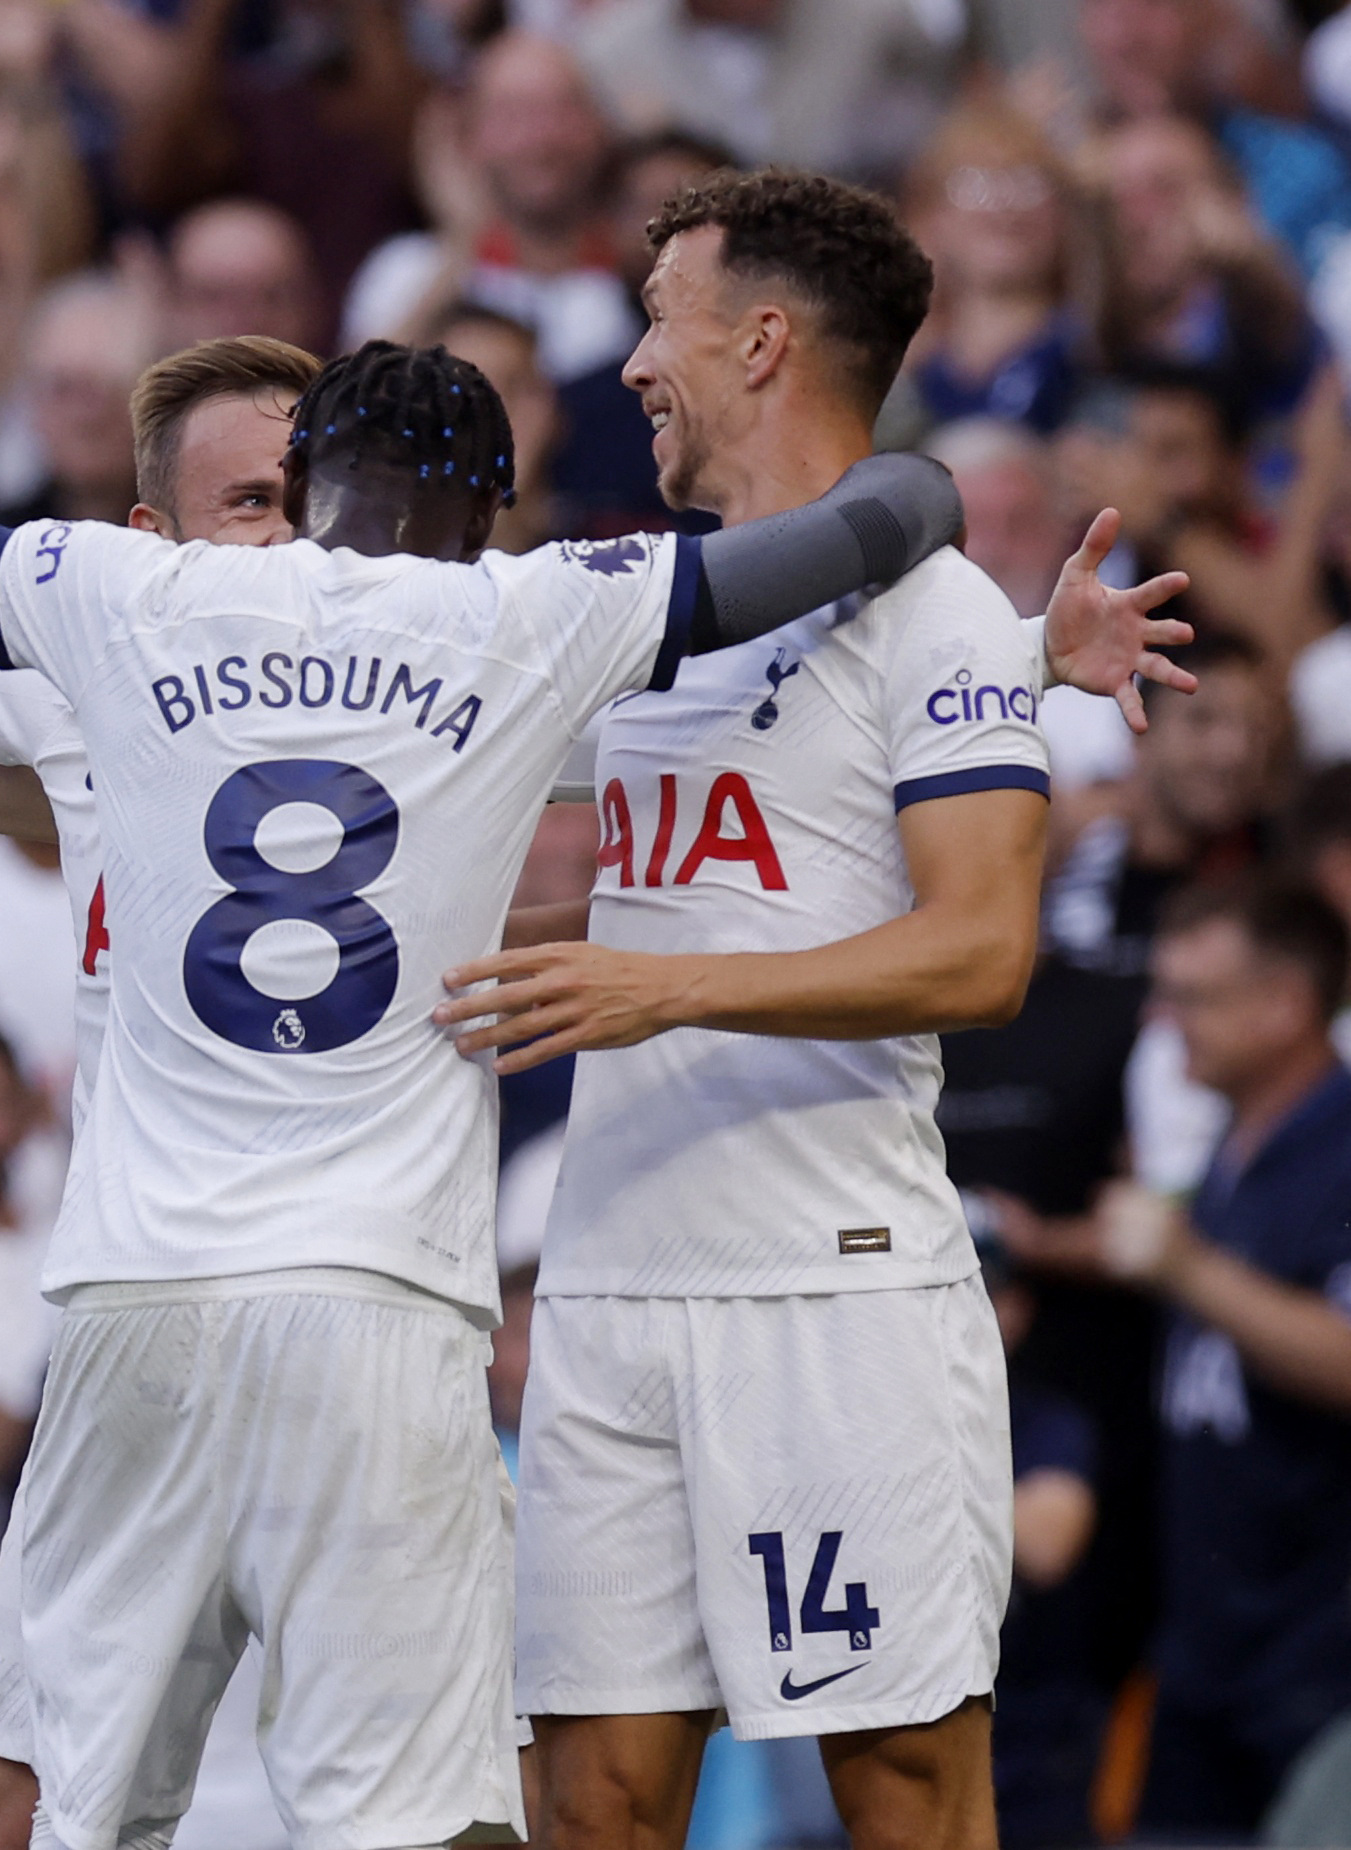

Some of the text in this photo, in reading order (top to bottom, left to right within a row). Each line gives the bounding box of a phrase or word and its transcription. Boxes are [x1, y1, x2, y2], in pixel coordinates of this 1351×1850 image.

[151, 652, 484, 754] BISSOUMA
[597, 771, 790, 891] AIA
[183, 758, 399, 1054] 8
[748, 1530, 880, 1652] 14
